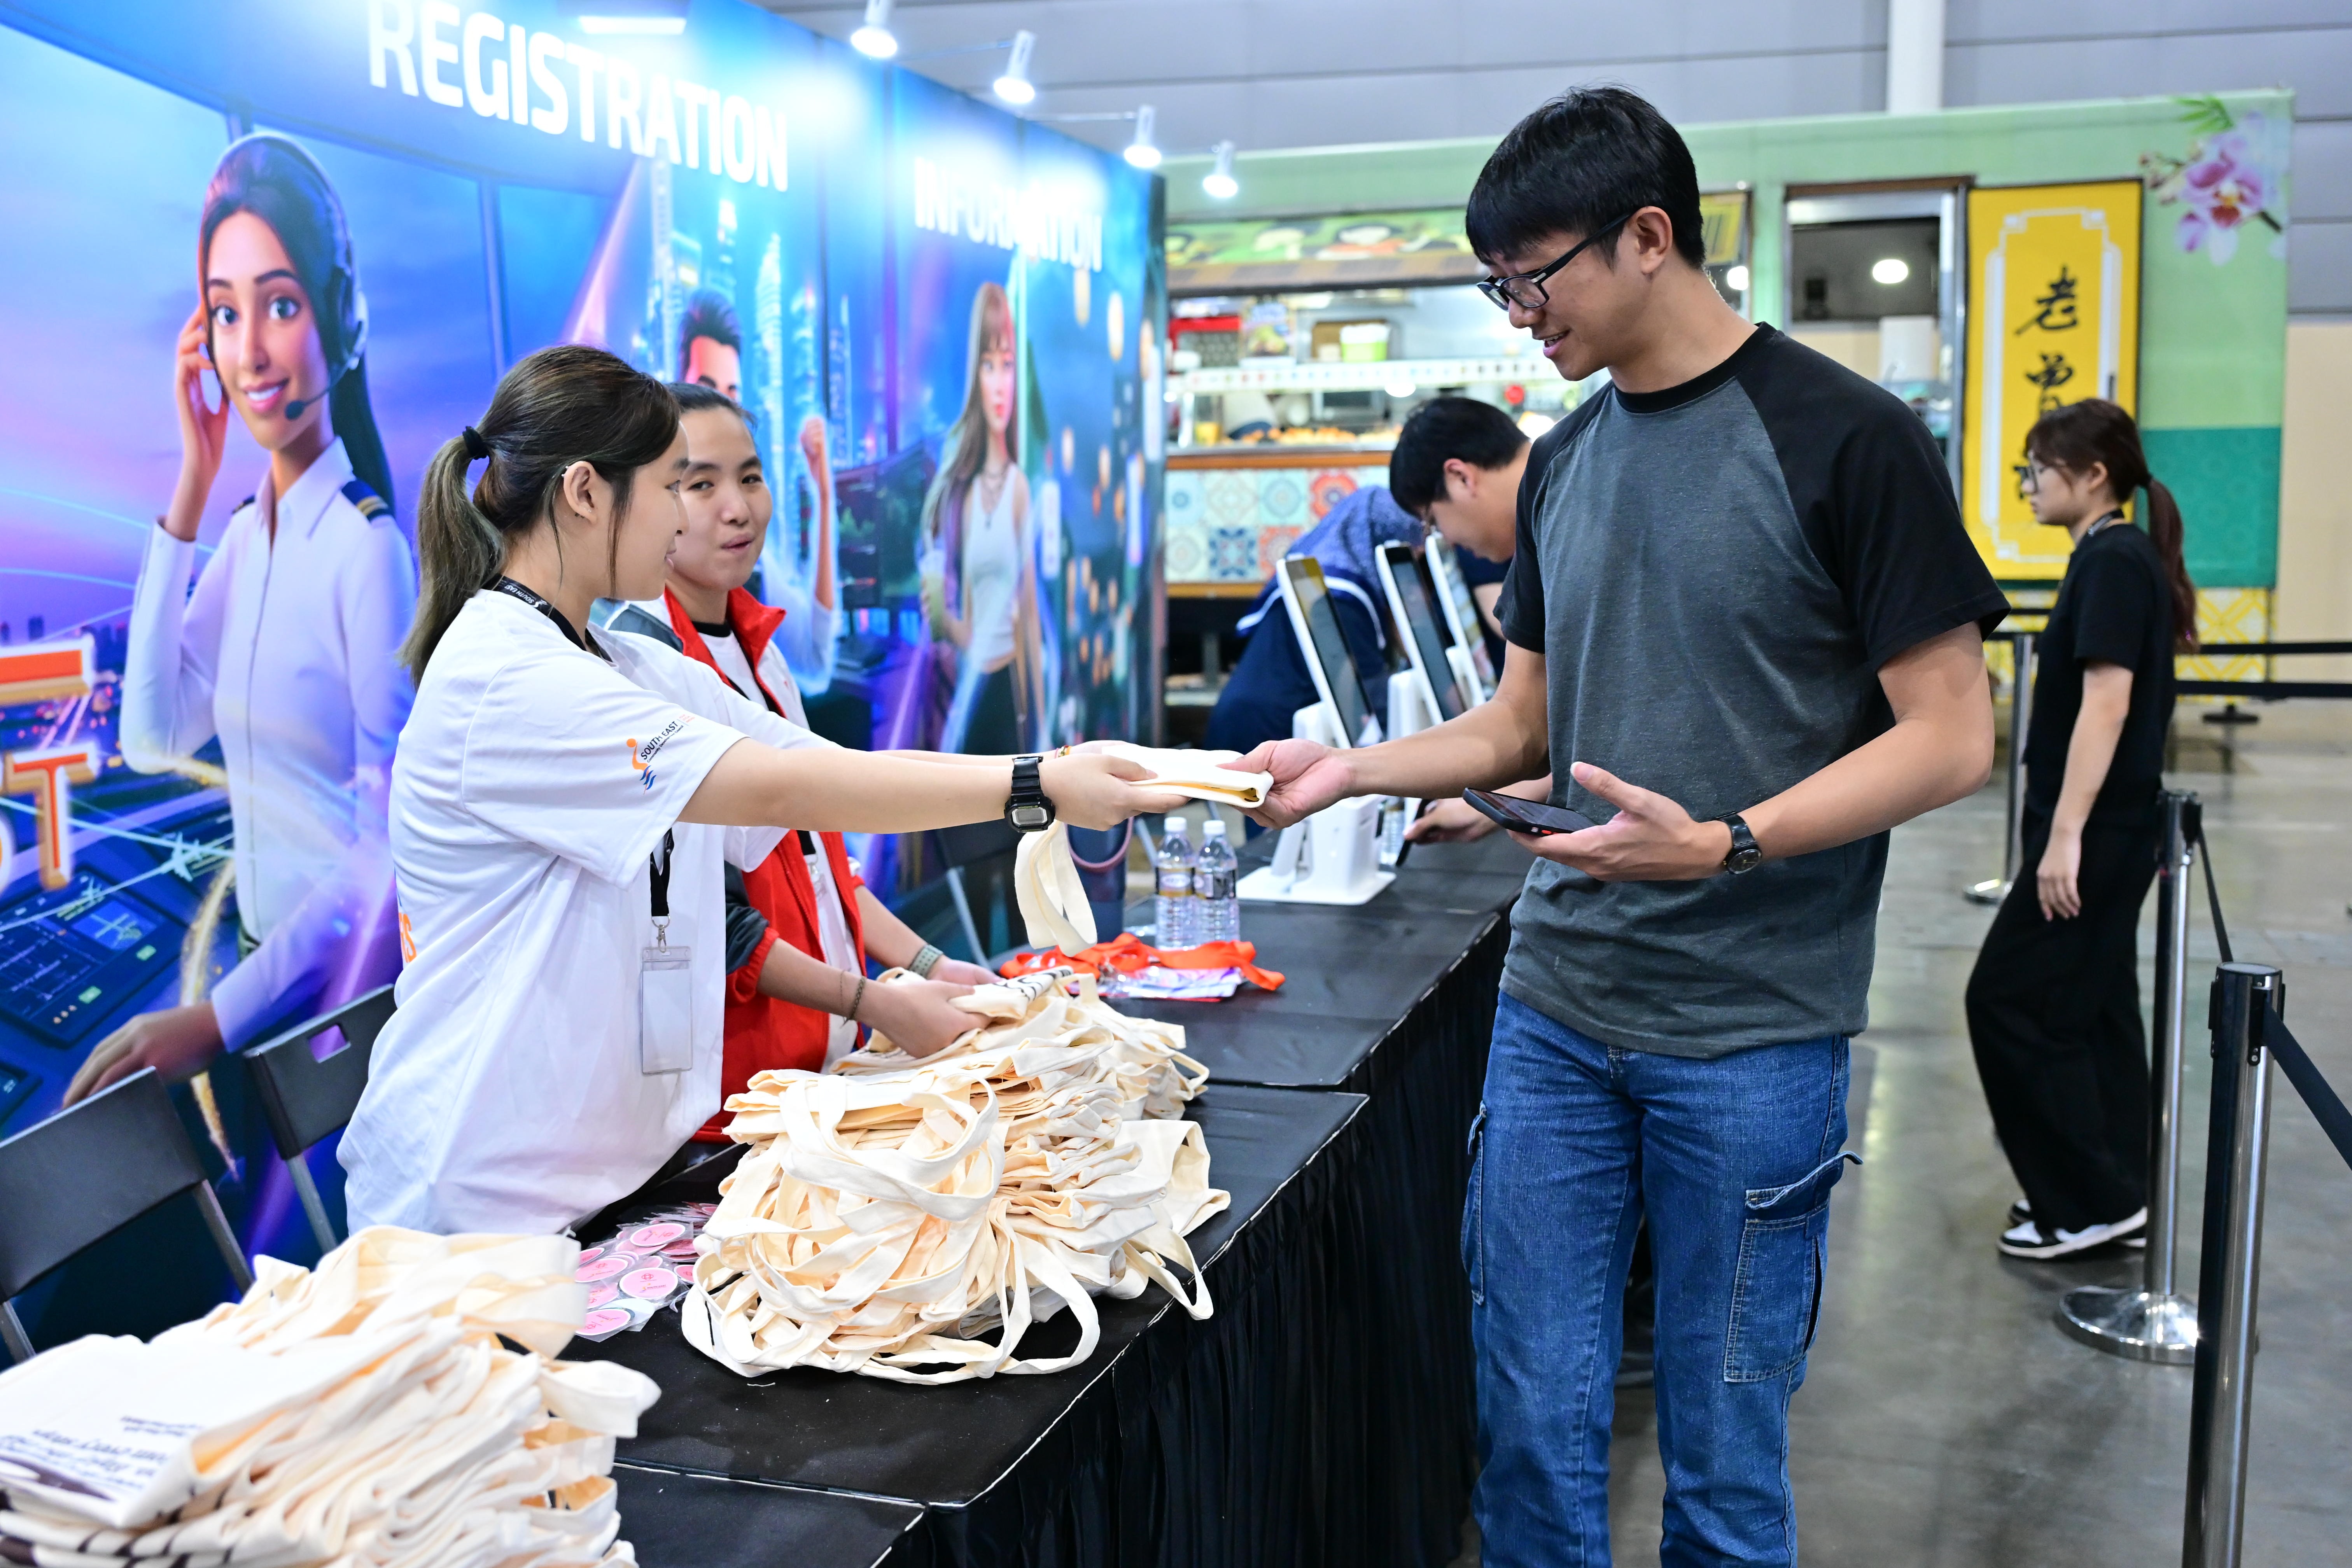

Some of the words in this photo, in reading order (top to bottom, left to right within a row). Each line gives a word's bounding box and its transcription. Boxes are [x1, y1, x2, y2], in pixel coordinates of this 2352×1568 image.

[368, 0, 788, 192] REGISTRATION
[504, 584, 518, 593] EAST
[516, 591, 534, 604] SOUTH
[640, 735, 663, 760] SOUTH
[661, 721, 678, 737] EAST
